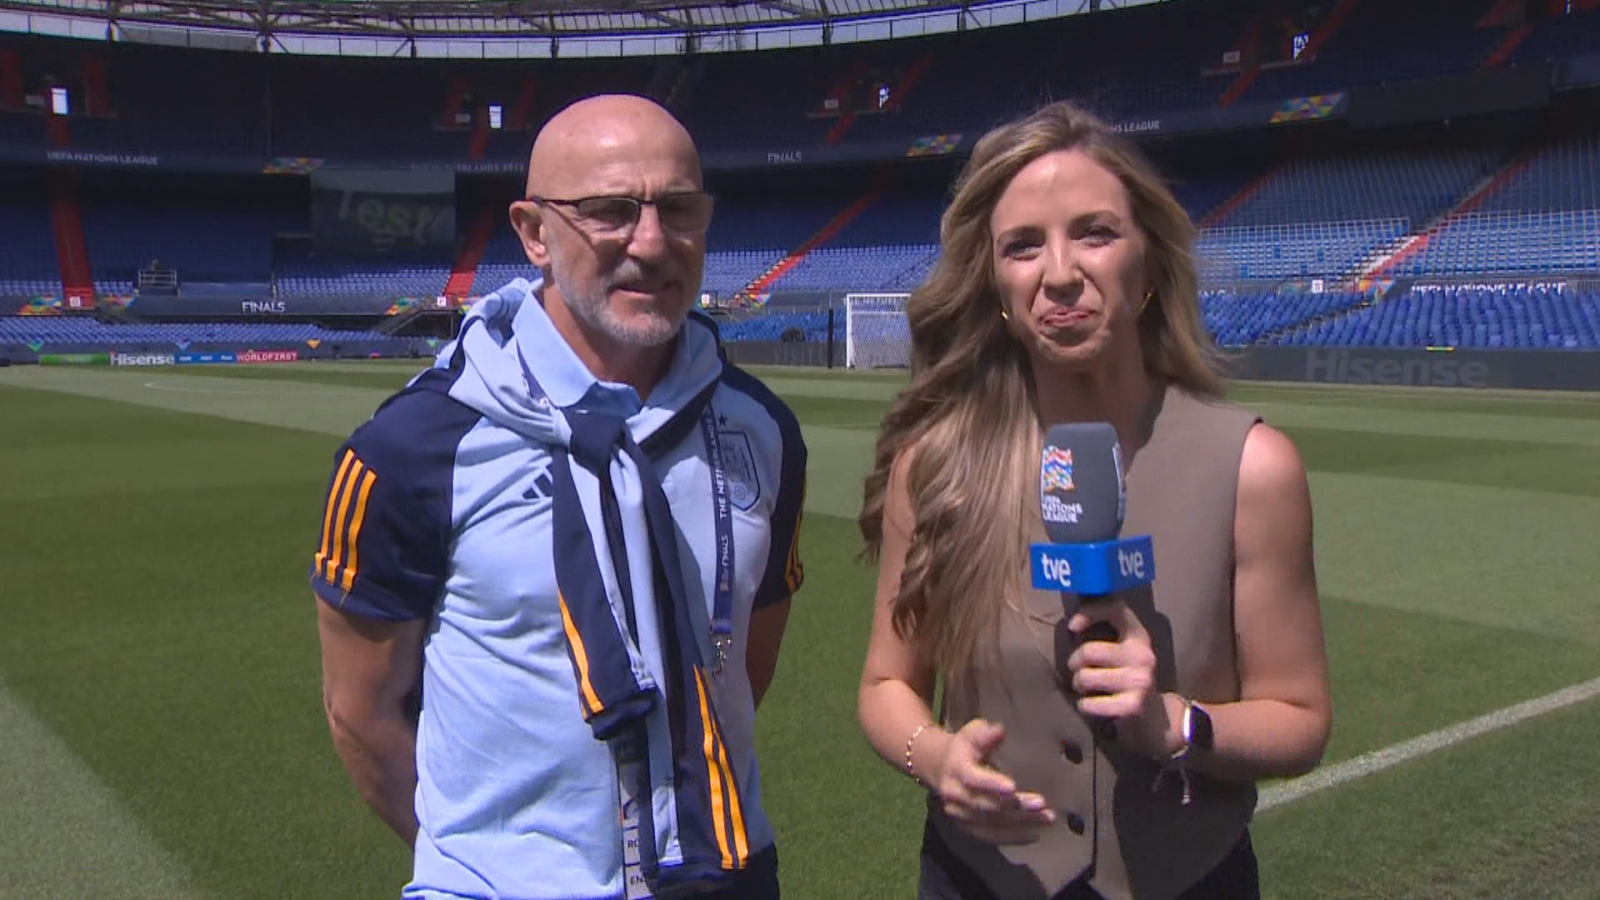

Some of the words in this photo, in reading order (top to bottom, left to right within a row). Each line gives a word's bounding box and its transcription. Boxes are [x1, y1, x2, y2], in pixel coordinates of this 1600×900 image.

[1124, 119, 1160, 132] LEAGUE
[74, 152, 119, 164] NATIONS
[120, 154, 158, 166] LEAGUE
[767, 151, 803, 164] FINALS
[242, 300, 285, 313] FINALS
[110, 352, 175, 366] Hisense
[236, 351, 298, 363] WORLDFIRST
[1306, 349, 1490, 387] Hisense
[718, 497, 728, 520] THE
[1041, 553, 1071, 587] tve
[1117, 549, 1145, 579] tve
